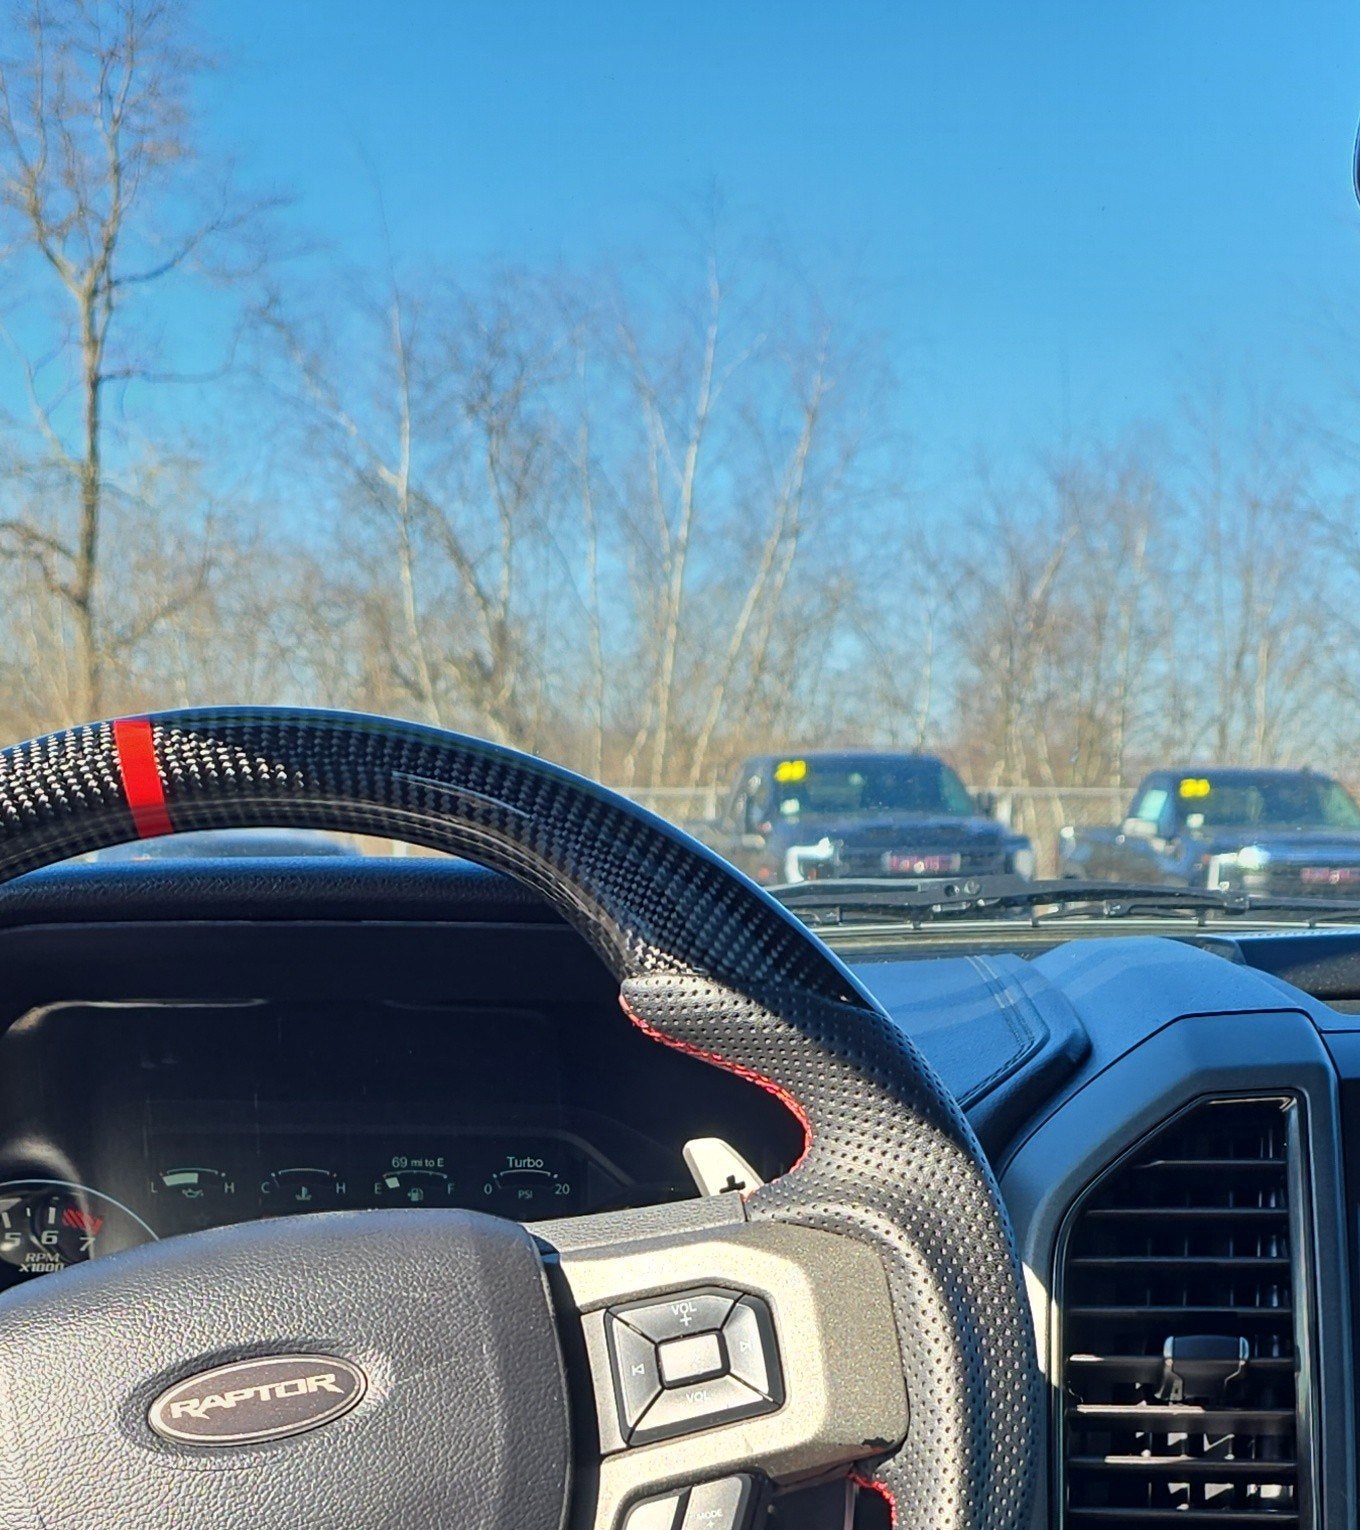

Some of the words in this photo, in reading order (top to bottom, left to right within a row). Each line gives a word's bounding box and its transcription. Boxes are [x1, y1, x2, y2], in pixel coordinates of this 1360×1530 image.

[392, 1157, 407, 1168] 69
[411, 1158, 422, 1167] mi
[425, 1158, 434, 1167] to
[437, 1157, 444, 1167] E
[506, 1156, 544, 1168] Turbo
[151, 1182, 158, 1193] L
[224, 1182, 235, 1193] H
[261, 1182, 270, 1193] C
[336, 1182, 346, 1194] H
[374, 1183, 381, 1194] E
[447, 1183, 454, 1194] F
[484, 1183, 492, 1195] 0
[555, 1183, 570, 1195] 20
[518, 1190, 533, 1199] PSI
[4, 1232, 22, 1247] 5
[41, 1230, 59, 1245] 6
[79, 1237, 96, 1252] 7
[25, 1253, 60, 1262] RPM
[671, 1302, 698, 1316] VOL
[170, 1373, 345, 1420] RAPTOR
[686, 1390, 710, 1403] VOL
[695, 1508, 724, 1521] MODE
